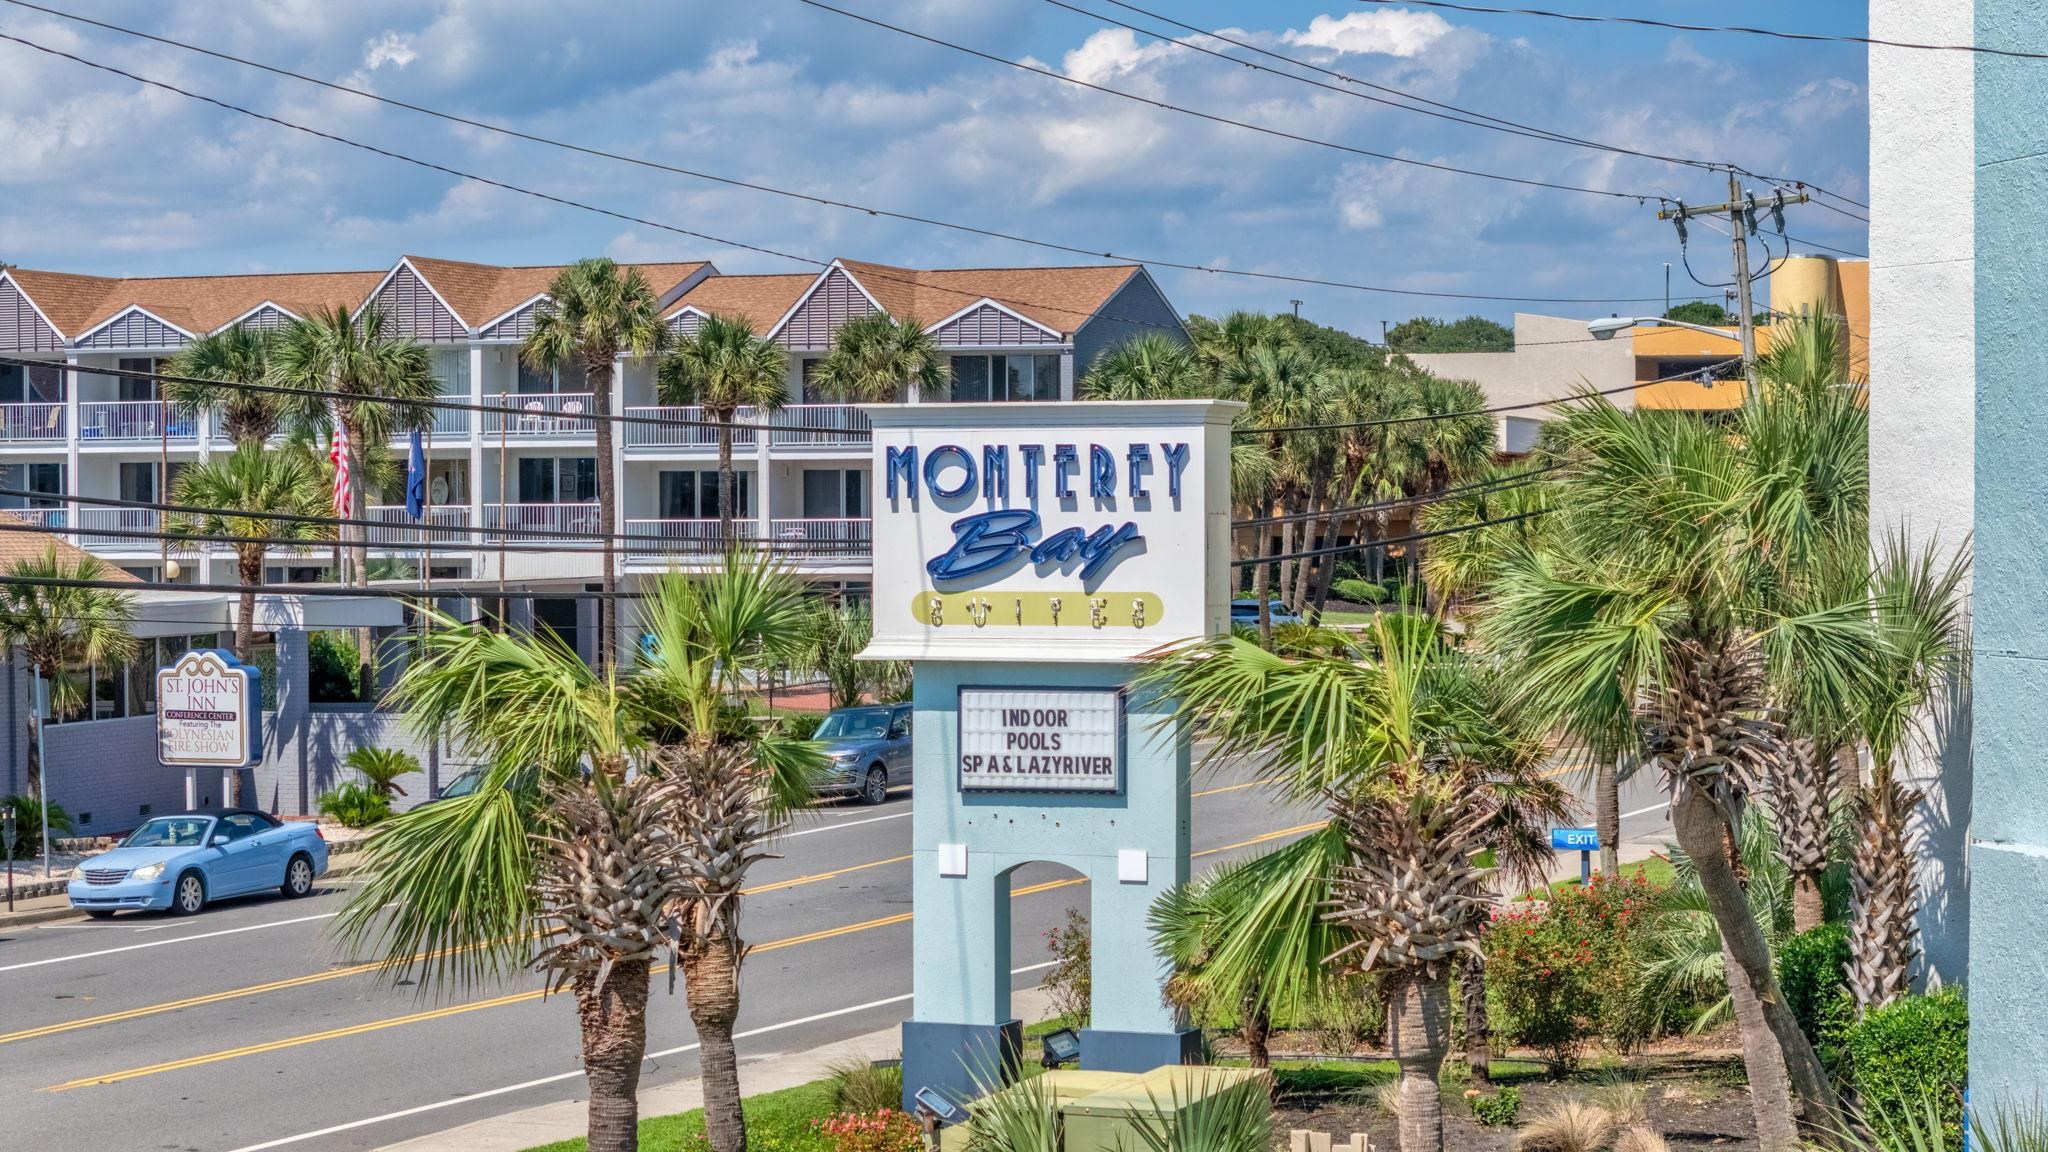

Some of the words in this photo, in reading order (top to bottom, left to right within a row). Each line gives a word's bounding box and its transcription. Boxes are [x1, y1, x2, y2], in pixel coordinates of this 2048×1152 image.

[886, 443, 1189, 499] MONTEREY
[926, 508, 1145, 581] Bay
[166, 678, 183, 693] ST.
[187, 678, 238, 695] JOHN'S
[187, 696, 216, 710] INN
[166, 711, 209, 719] CONFERENCE
[209, 712, 234, 720] CENTER
[1002, 709, 1068, 728] INDOOR
[179, 720, 208, 729] Featuring
[210, 721, 222, 729] The
[164, 728, 234, 741] POLYNESIAN
[1006, 732, 1061, 751] POOLS
[168, 741, 192, 752] FIRE
[194, 741, 230, 753] SHOW
[1567, 834, 1595, 845] EXIT
